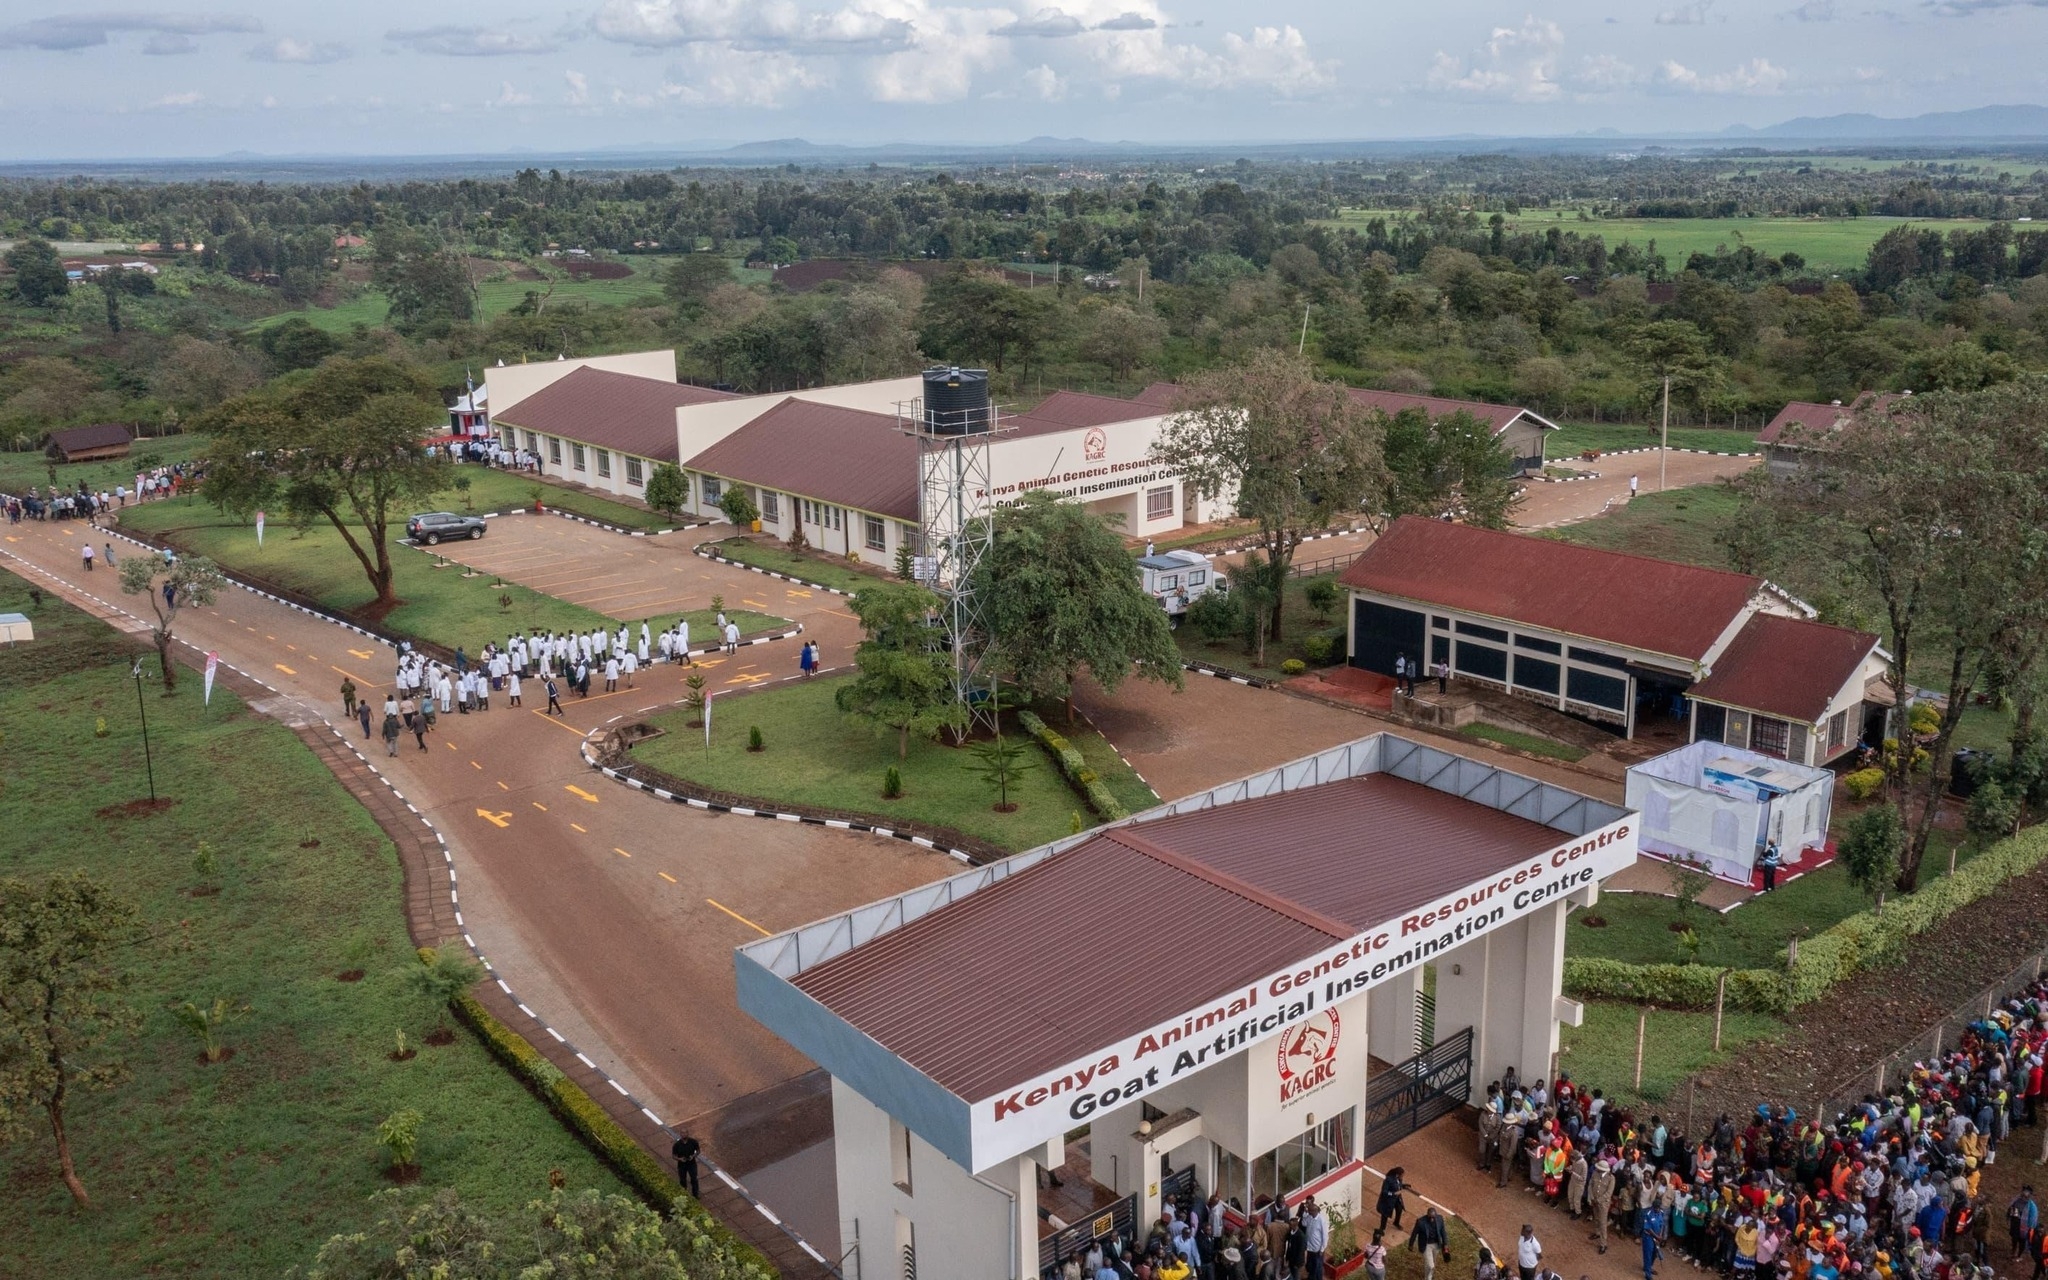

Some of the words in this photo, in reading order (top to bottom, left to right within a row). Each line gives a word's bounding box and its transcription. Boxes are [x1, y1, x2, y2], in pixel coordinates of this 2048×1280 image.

[1085, 451, 1106, 461] KAGRC
[1018, 475, 1060, 491] Animal
[1063, 467, 1108, 482] Genetic
[1080, 473, 1156, 496] Insemination
[994, 1056, 1120, 1122] Kenya
[1134, 988, 1257, 1061] Animal
[1269, 934, 1389, 998] Genetic
[1401, 864, 1543, 938] Resources
[1551, 826, 1630, 868] Centre
[1069, 1067, 1159, 1120] Goat
[1170, 991, 1314, 1077] Artificial
[1325, 905, 1504, 1003] Insemination
[1513, 868, 1594, 910] Centre
[1281, 1058, 1337, 1103] KAGRC
